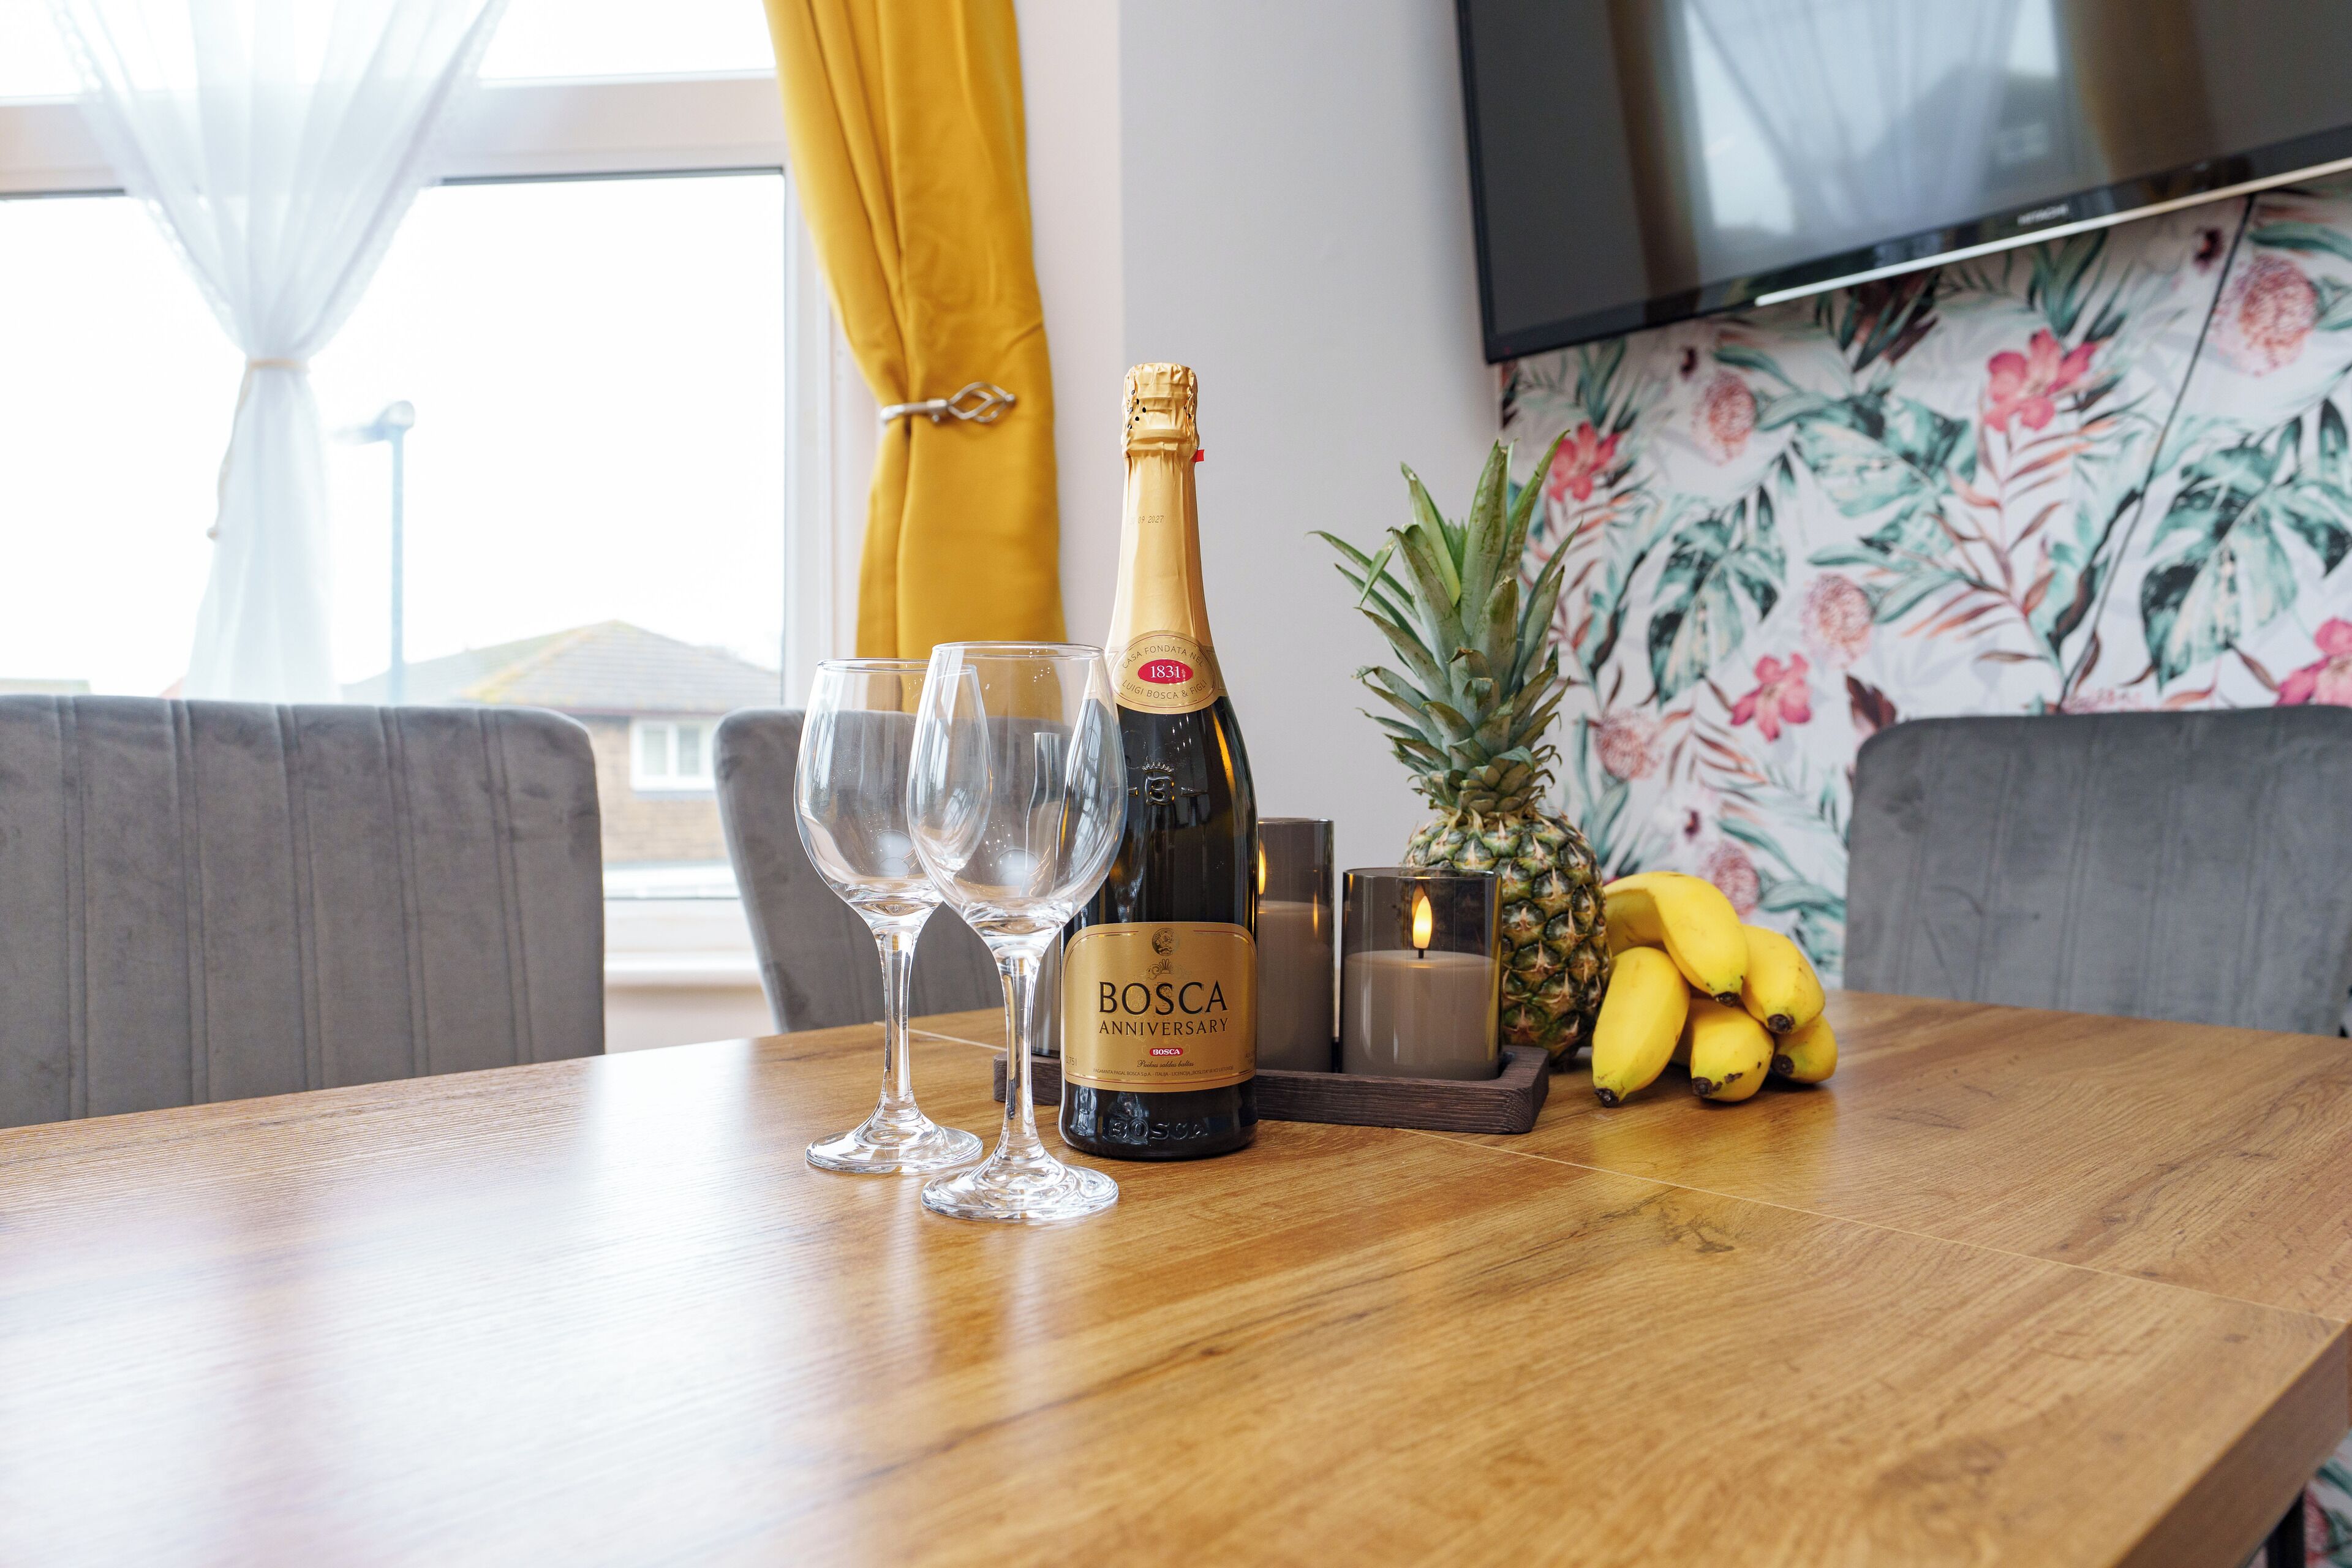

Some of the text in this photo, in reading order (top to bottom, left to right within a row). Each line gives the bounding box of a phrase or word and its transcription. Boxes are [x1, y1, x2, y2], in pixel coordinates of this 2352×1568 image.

[1122, 645, 1204, 669] CASA FONDATA NEL
[1150, 665, 1180, 678] 1831
[1122, 680, 1144, 695] LUIGI
[1147, 690, 1178, 699] BOSCA
[1189, 680, 1207, 695] FIGLI
[1099, 980, 1228, 1016] BOSCA
[1099, 1017, 1229, 1036] ANNIVERSARY
